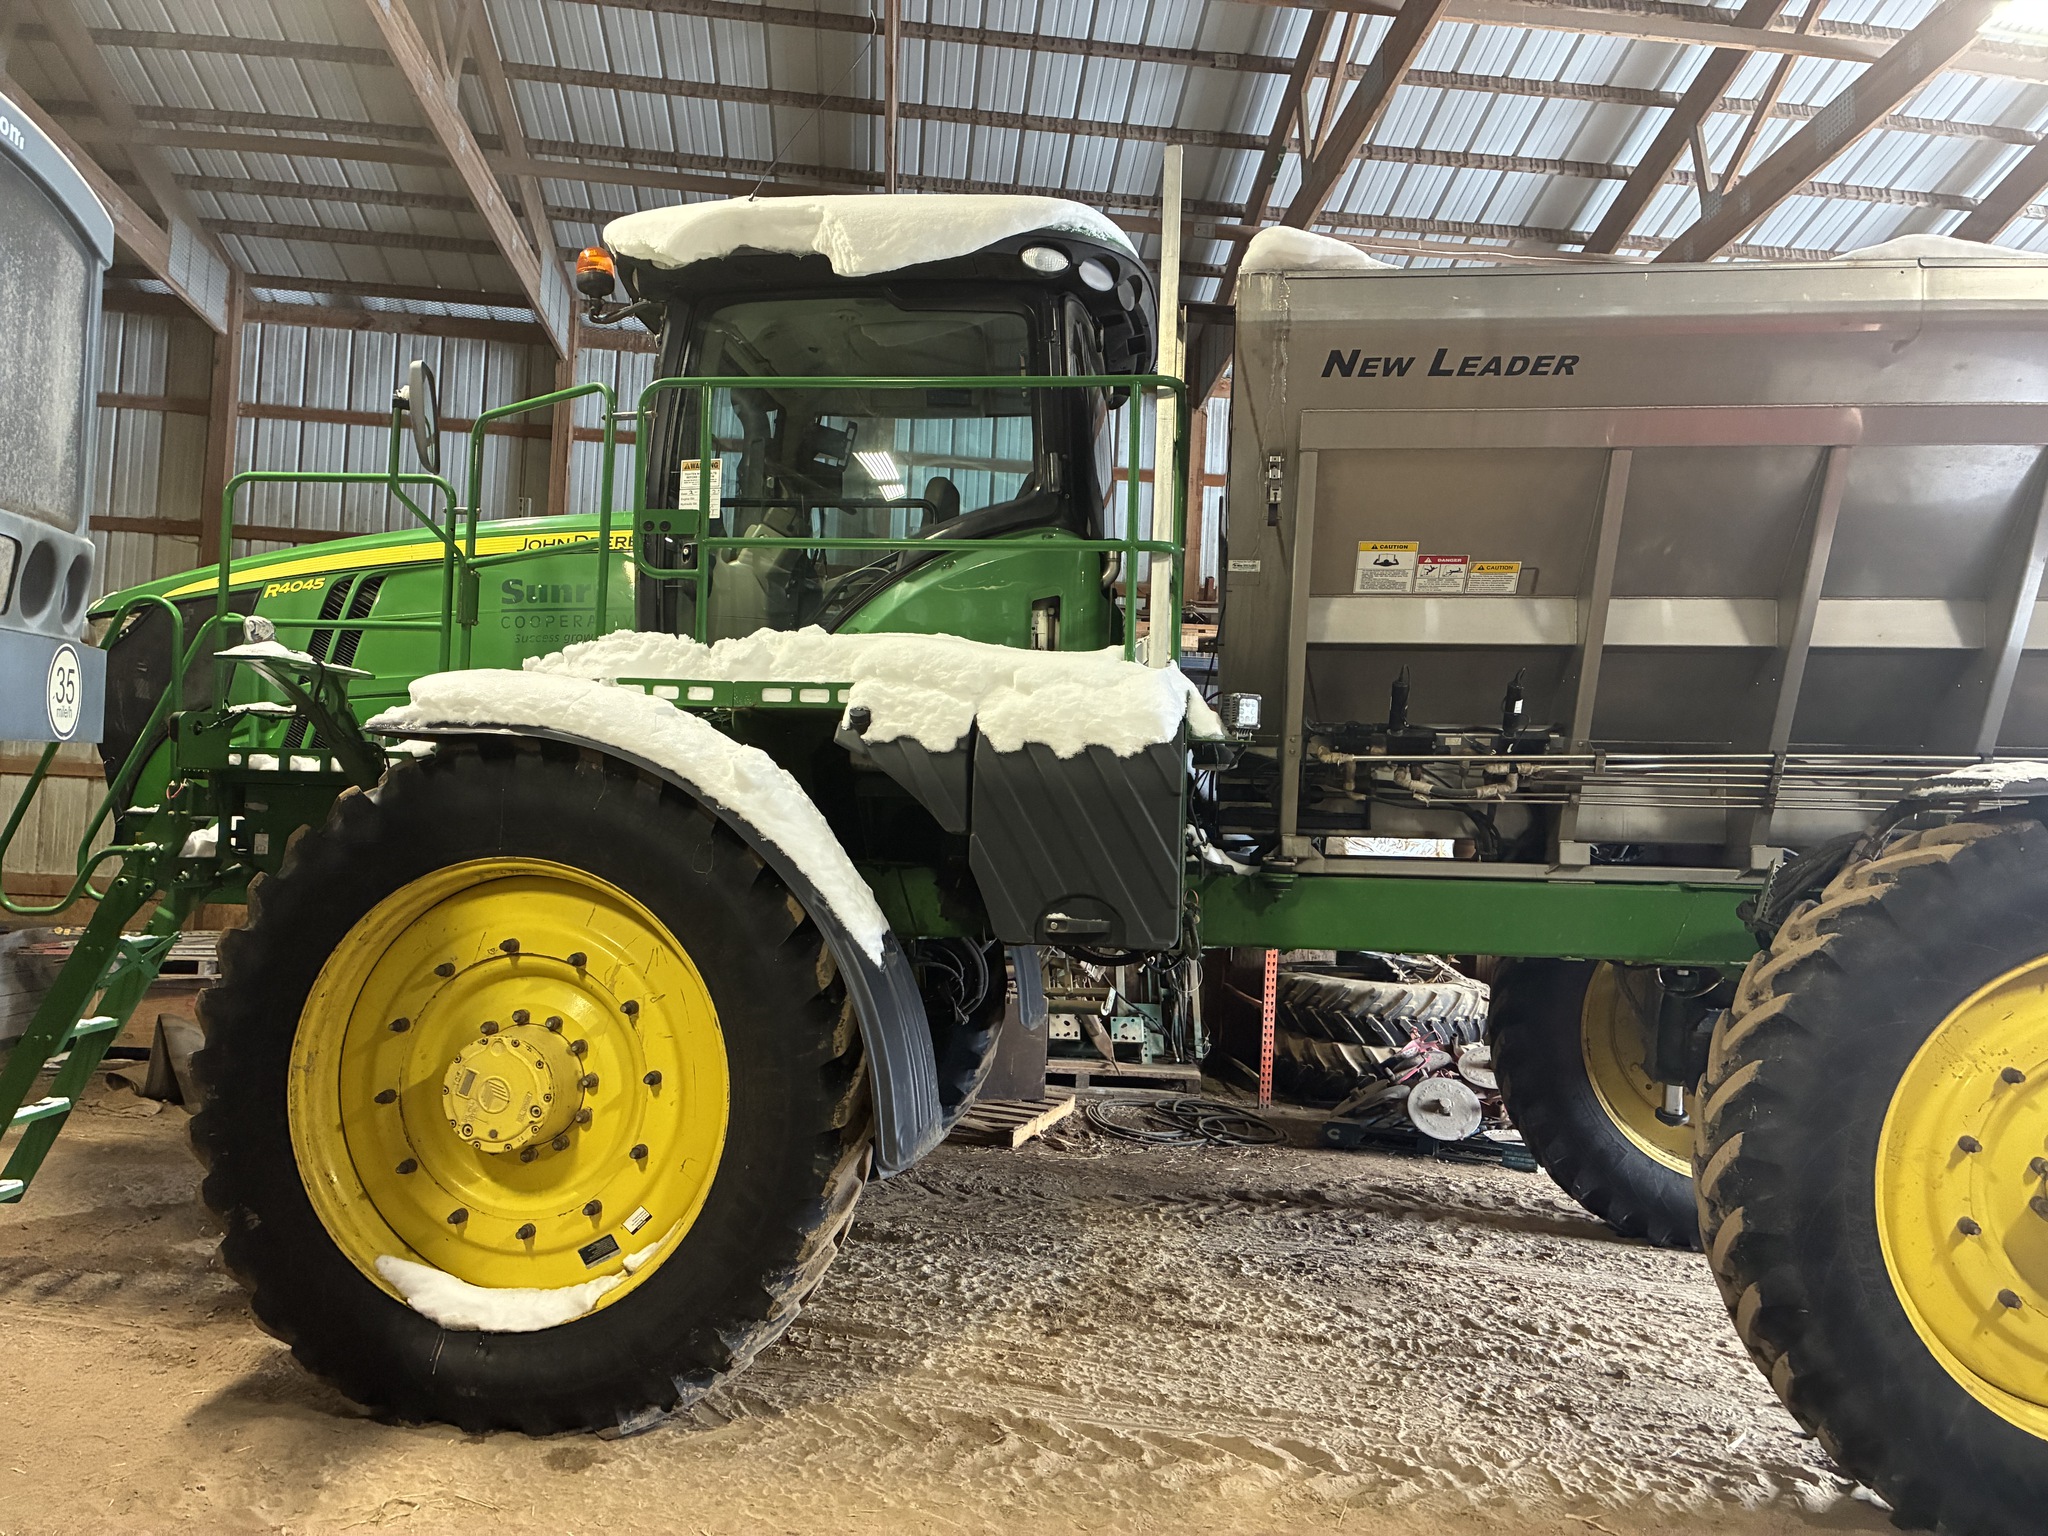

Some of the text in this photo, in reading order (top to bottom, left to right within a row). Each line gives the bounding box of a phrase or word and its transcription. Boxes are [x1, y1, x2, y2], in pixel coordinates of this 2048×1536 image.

[690, 461, 719, 470] WANG
[263, 577, 326, 599] R4045
[501, 578, 592, 605] Sunr
[563, 632, 595, 644] grow
[55, 666, 75, 705] 35
